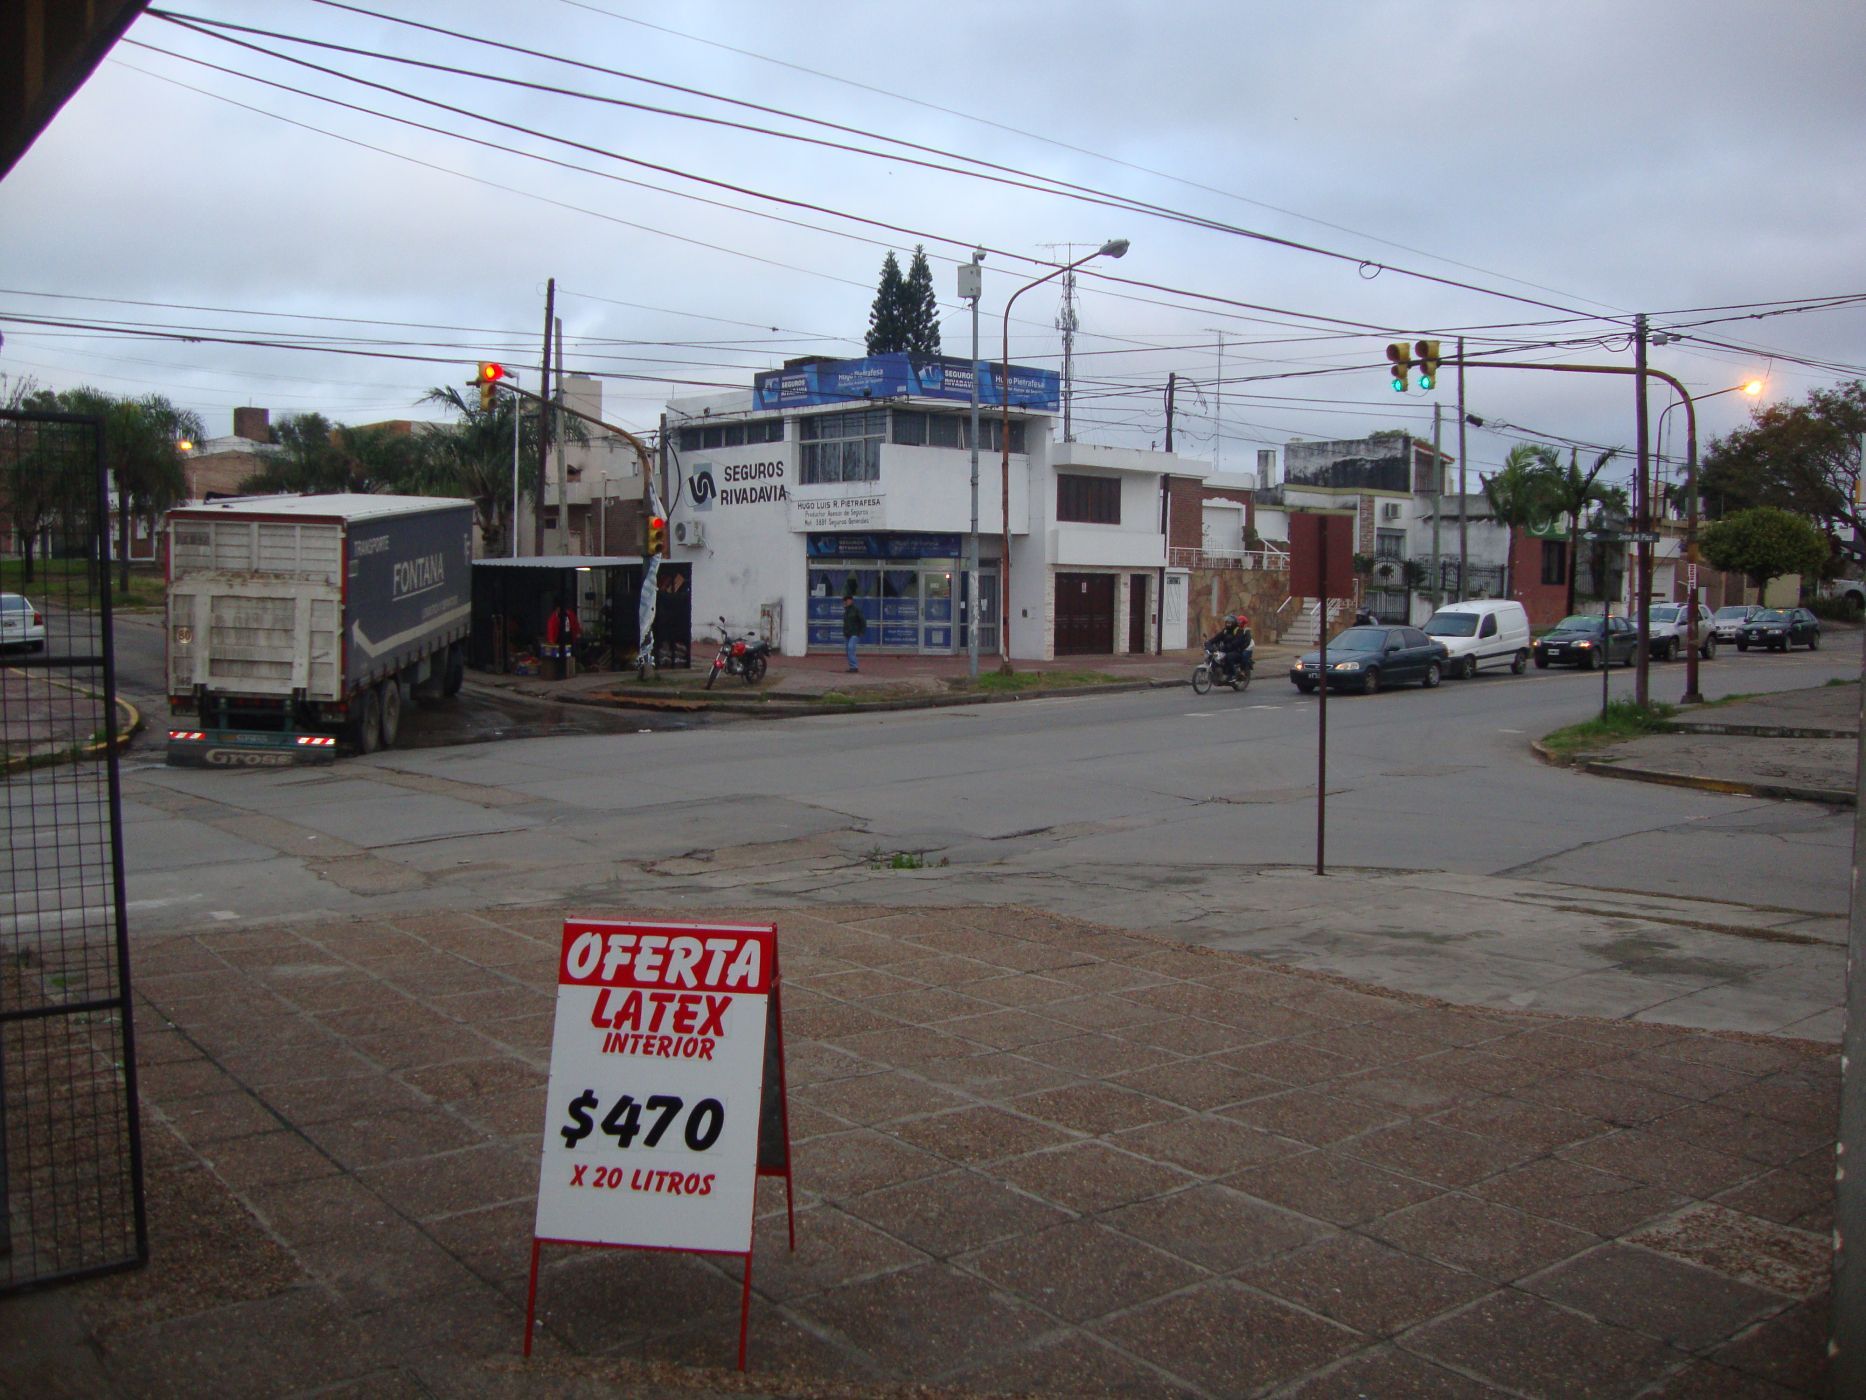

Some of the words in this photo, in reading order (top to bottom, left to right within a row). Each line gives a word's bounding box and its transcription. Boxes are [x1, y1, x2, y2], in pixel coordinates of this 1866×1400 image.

[944, 369, 975, 380] SEGUROS
[724, 460, 784, 483] SEGUROS
[720, 484, 787, 506] RIVADAVIA
[797, 502, 815, 511] HUGO
[816, 501, 831, 510] LUIS
[840, 498, 881, 508] PIETRAFESA
[354, 535, 390, 558] TRANSPORTE
[393, 552, 445, 596] FONTANA
[565, 930, 762, 989] OFERTA
[590, 987, 733, 1038] LATEX
[602, 1032, 716, 1062] INTERIOR
[560, 1088, 725, 1152] $470
[569, 1164, 589, 1187] X
[593, 1166, 624, 1190] 20
[631, 1169, 716, 1196] LITROS
